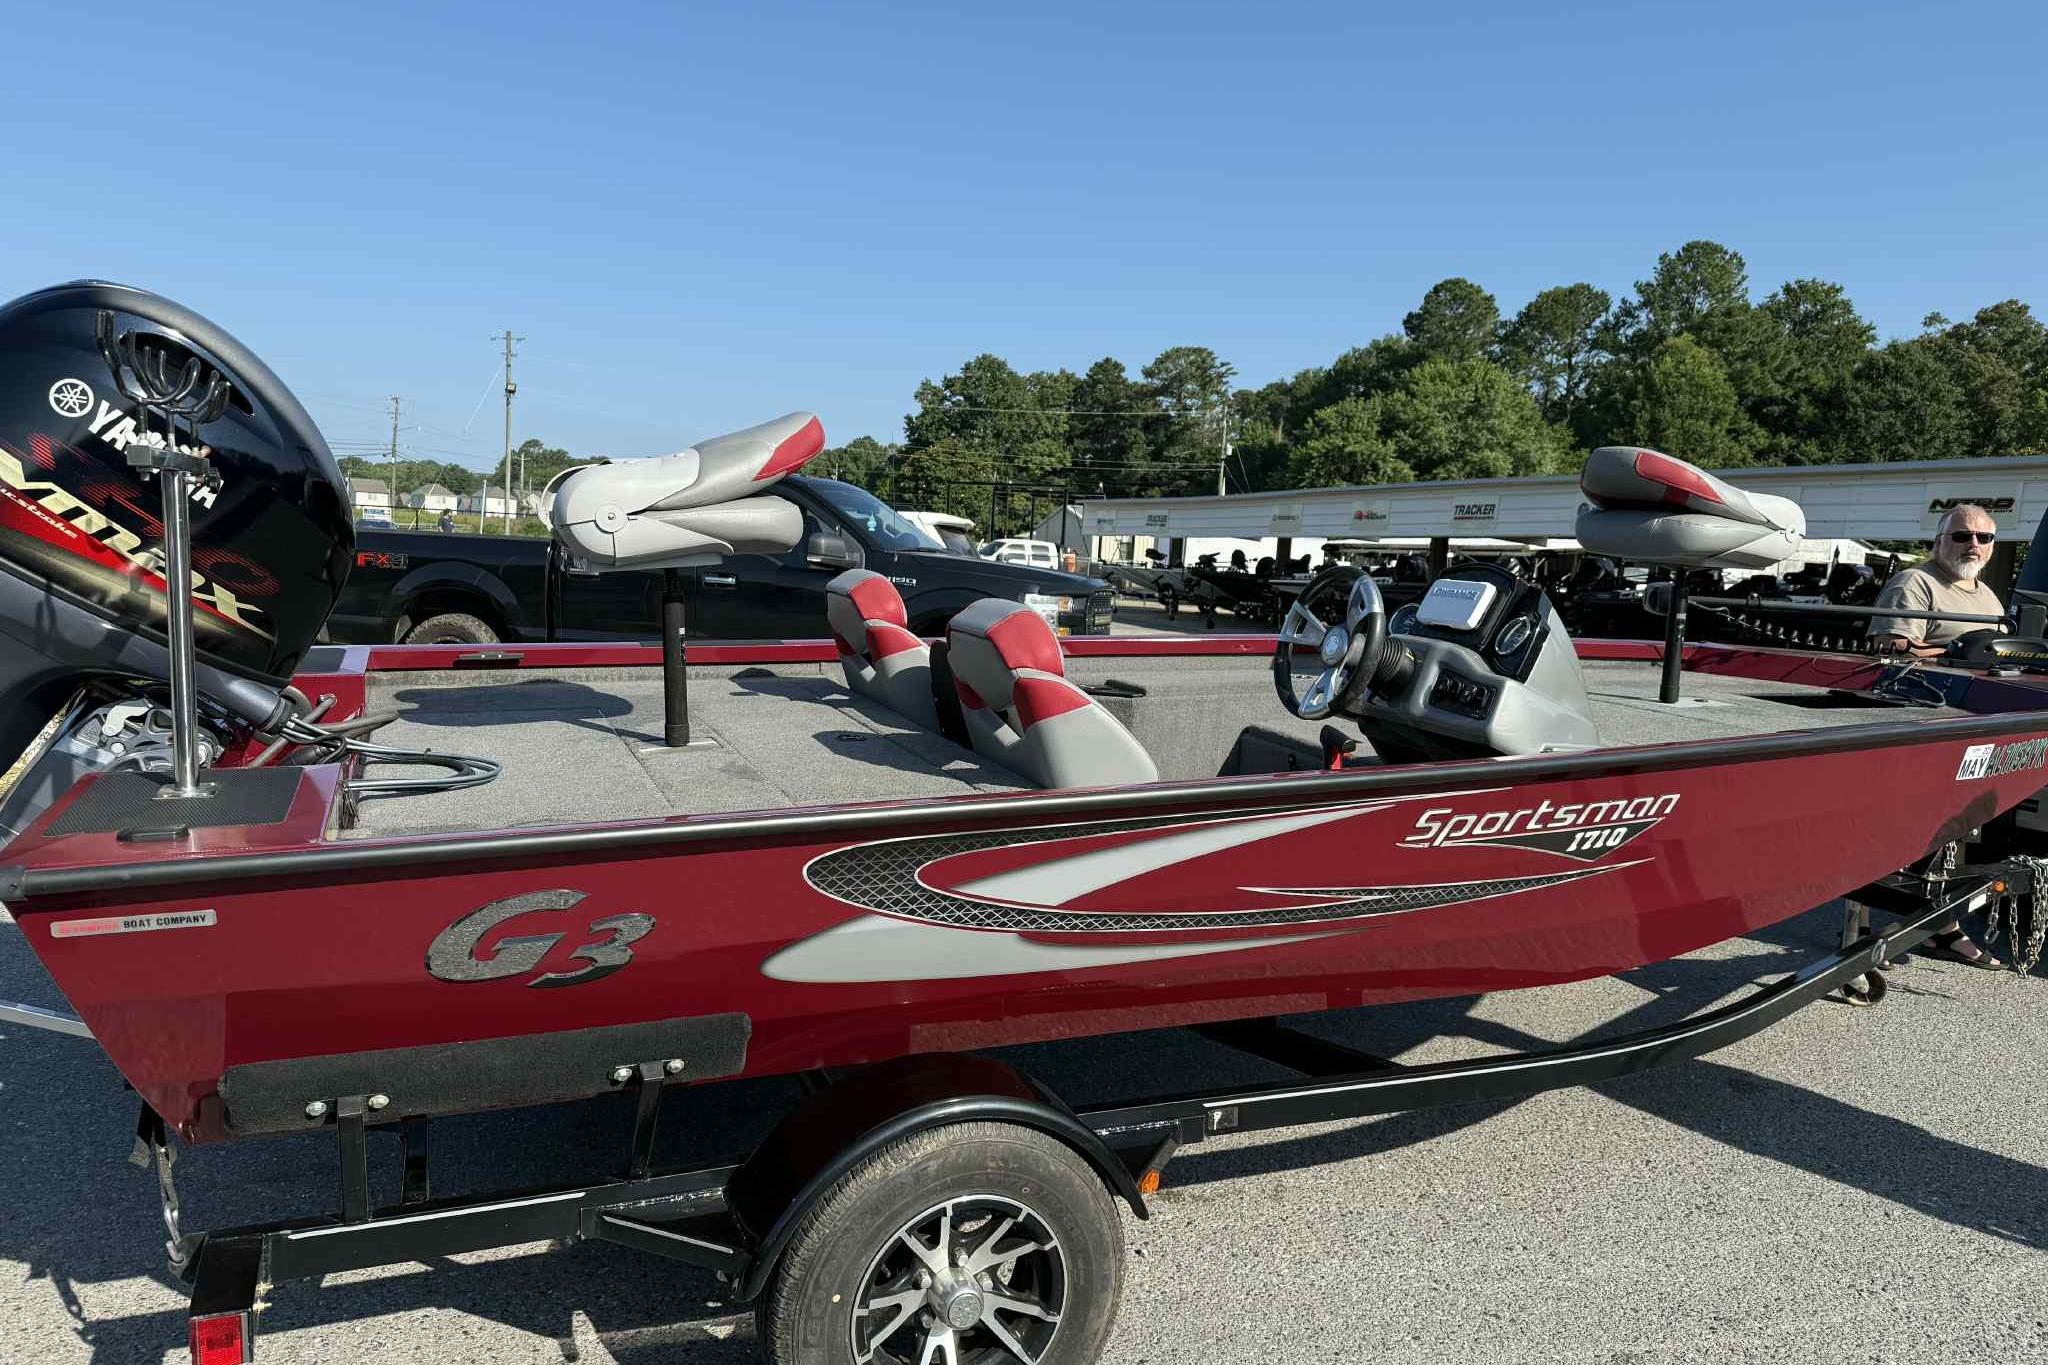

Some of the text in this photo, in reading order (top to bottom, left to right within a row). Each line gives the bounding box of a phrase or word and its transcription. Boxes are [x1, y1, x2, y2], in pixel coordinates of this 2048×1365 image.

[1455, 504, 1496, 516] TRACKER
[357, 552, 409, 569] FX4
[1959, 758, 1988, 778] MAY
[1404, 793, 1681, 847] Sportsman
[1566, 828, 1628, 851] 1710
[123, 918, 152, 929] BOAT
[156, 914, 206, 926] COMPANY
[424, 888, 657, 989] G3
